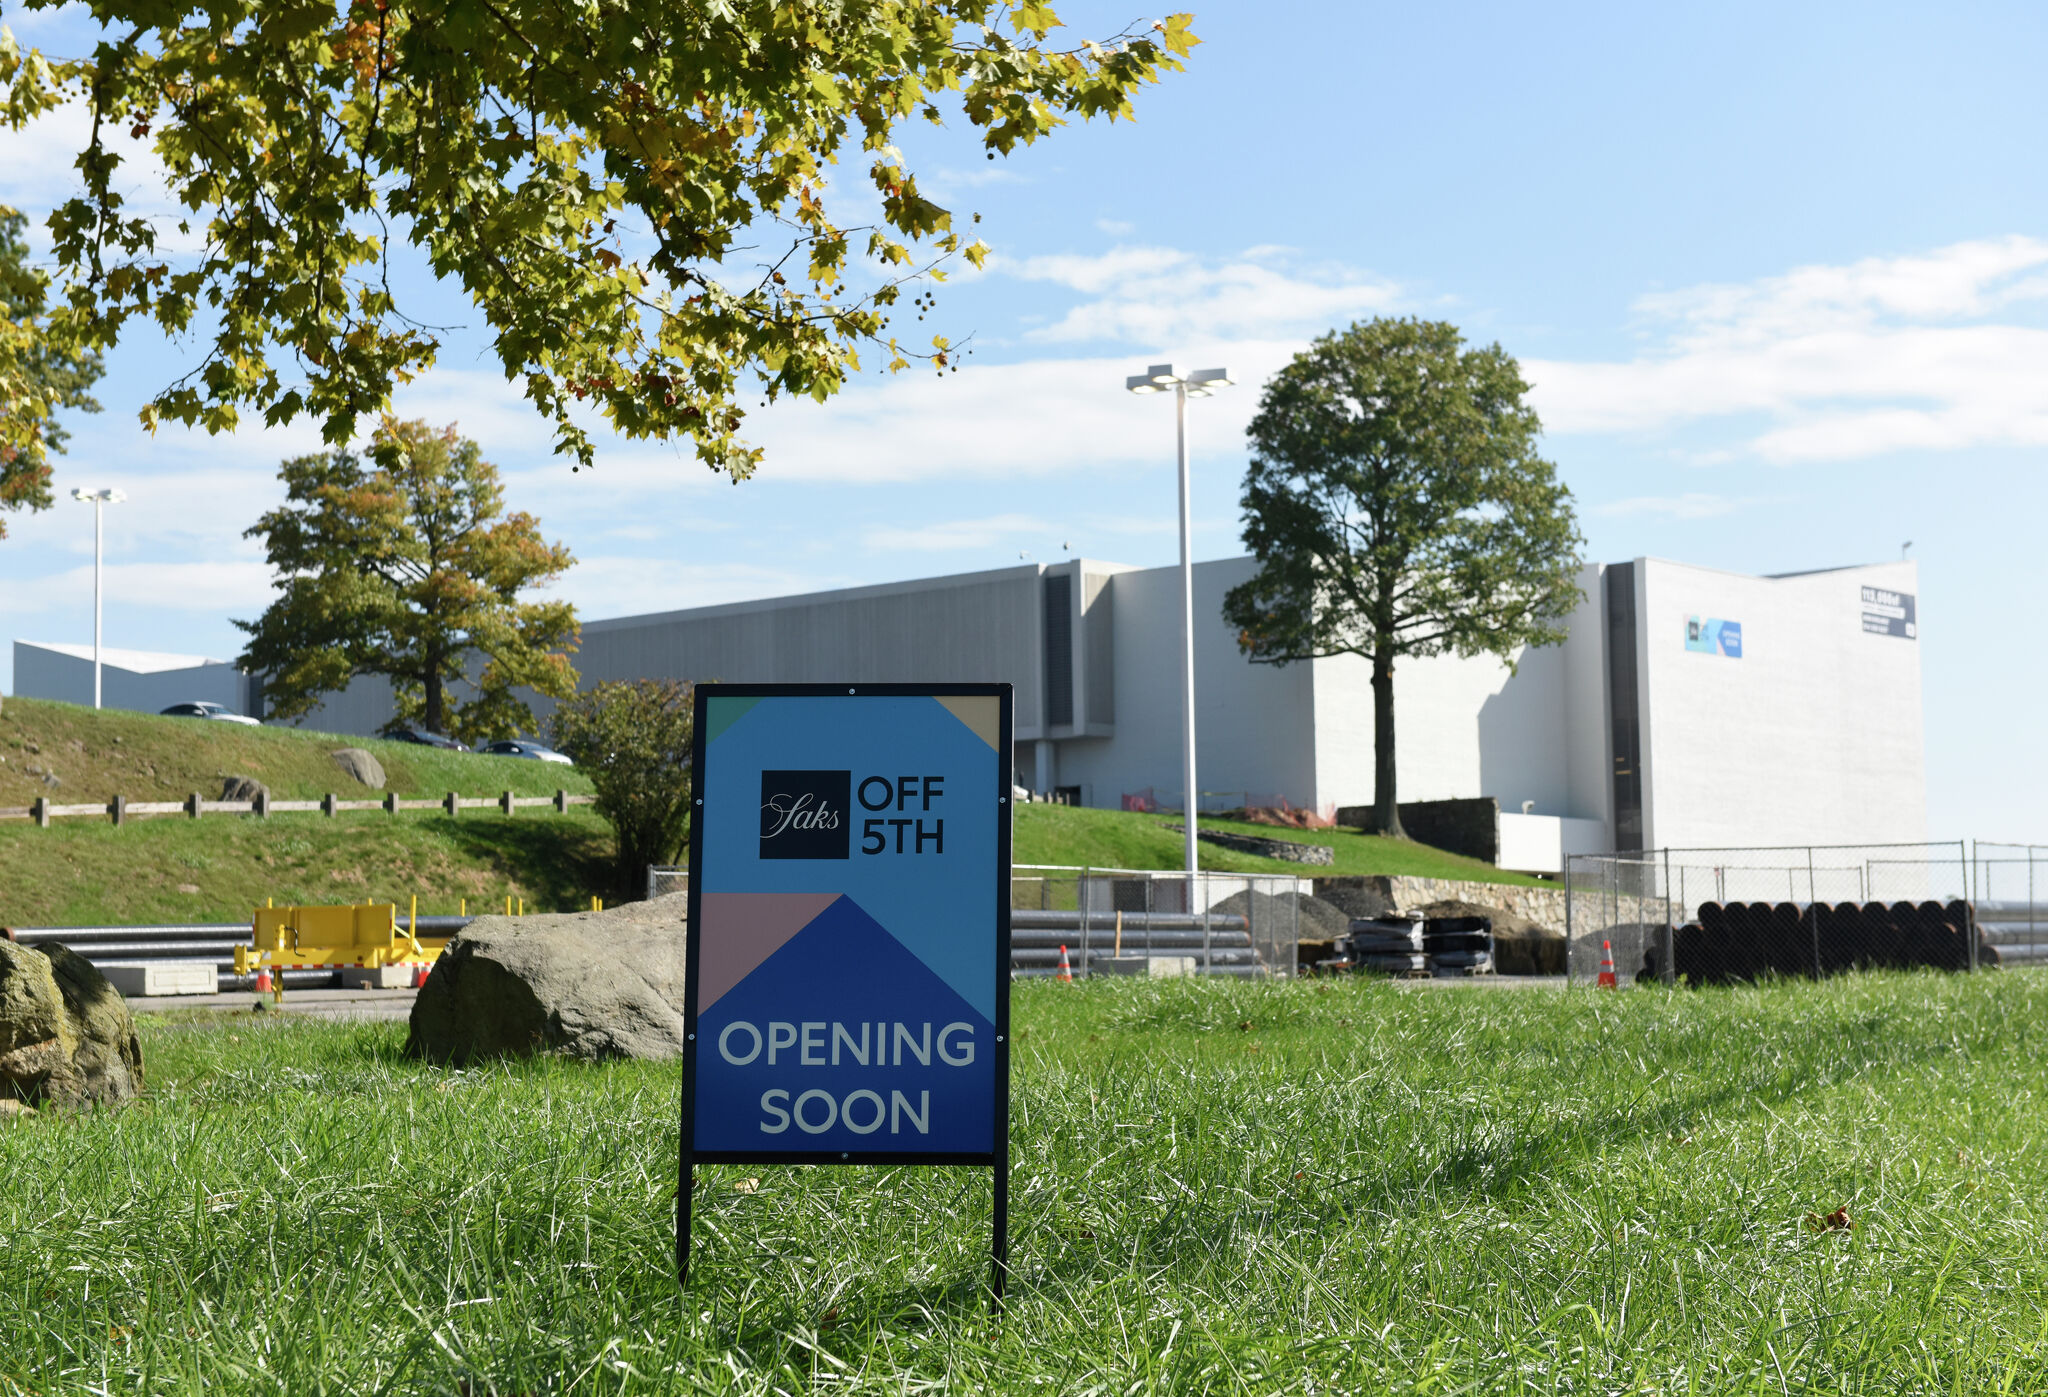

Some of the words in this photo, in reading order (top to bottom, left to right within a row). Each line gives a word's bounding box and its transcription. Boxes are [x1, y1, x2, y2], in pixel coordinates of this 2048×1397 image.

[761, 792, 839, 838] Saks
[858, 775, 945, 811] OFF
[861, 819, 944, 855] 5TH
[718, 1021, 975, 1066] OPENING
[760, 1089, 930, 1135] SOON
